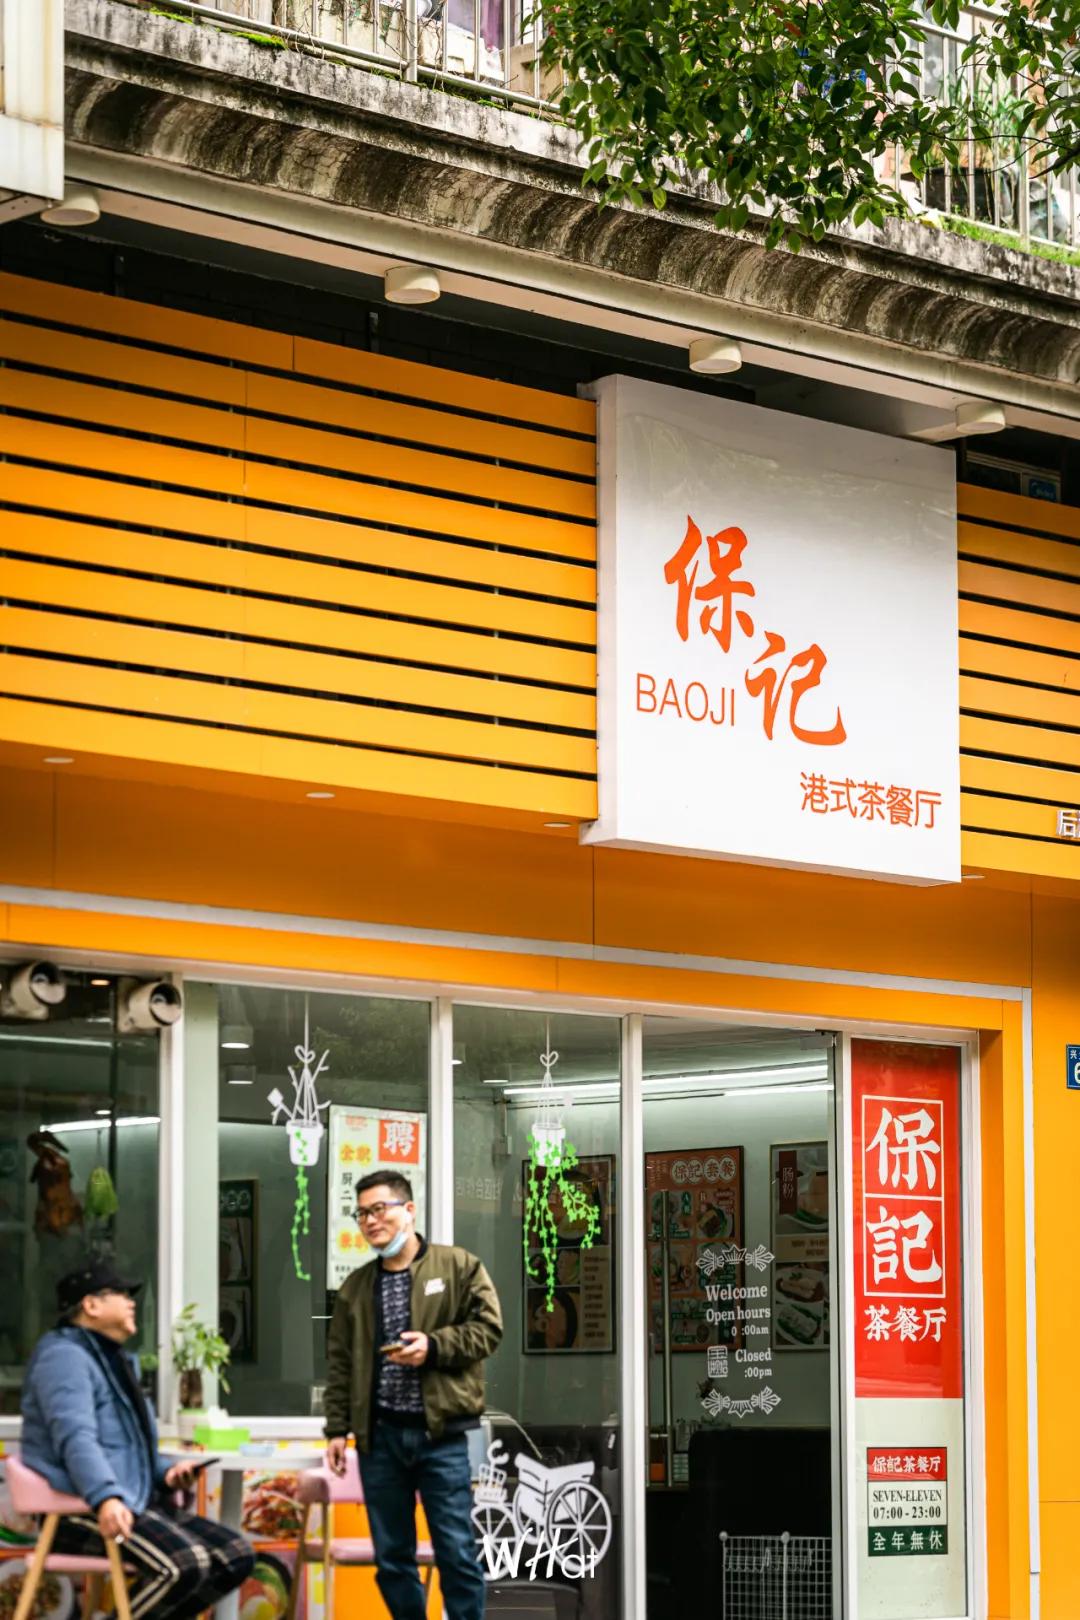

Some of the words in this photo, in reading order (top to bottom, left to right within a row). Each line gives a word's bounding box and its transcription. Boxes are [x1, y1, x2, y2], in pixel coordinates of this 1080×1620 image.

[663, 514, 847, 746] 保记
[635, 672, 735, 727] BAOJI
[800, 771, 942, 829] 港式茶餐厅
[383, 1122, 416, 1157] 聘
[865, 1106, 942, 1286] 保記
[705, 1283, 768, 1301] Welcome
[706, 1308, 735, 1325] Open
[736, 1305, 771, 1320] hours
[864, 1304, 946, 1342] 茶餐厅
[735, 1347, 772, 1363] Closed
[872, 1455, 941, 1473] 保記茶餐厅
[873, 1489, 942, 1502] SEVEN-ELEVEN
[873, 1506, 903, 1519] 07:00
[912, 1505, 941, 1519] 23:00
[873, 1530, 943, 1551] 全年無休
